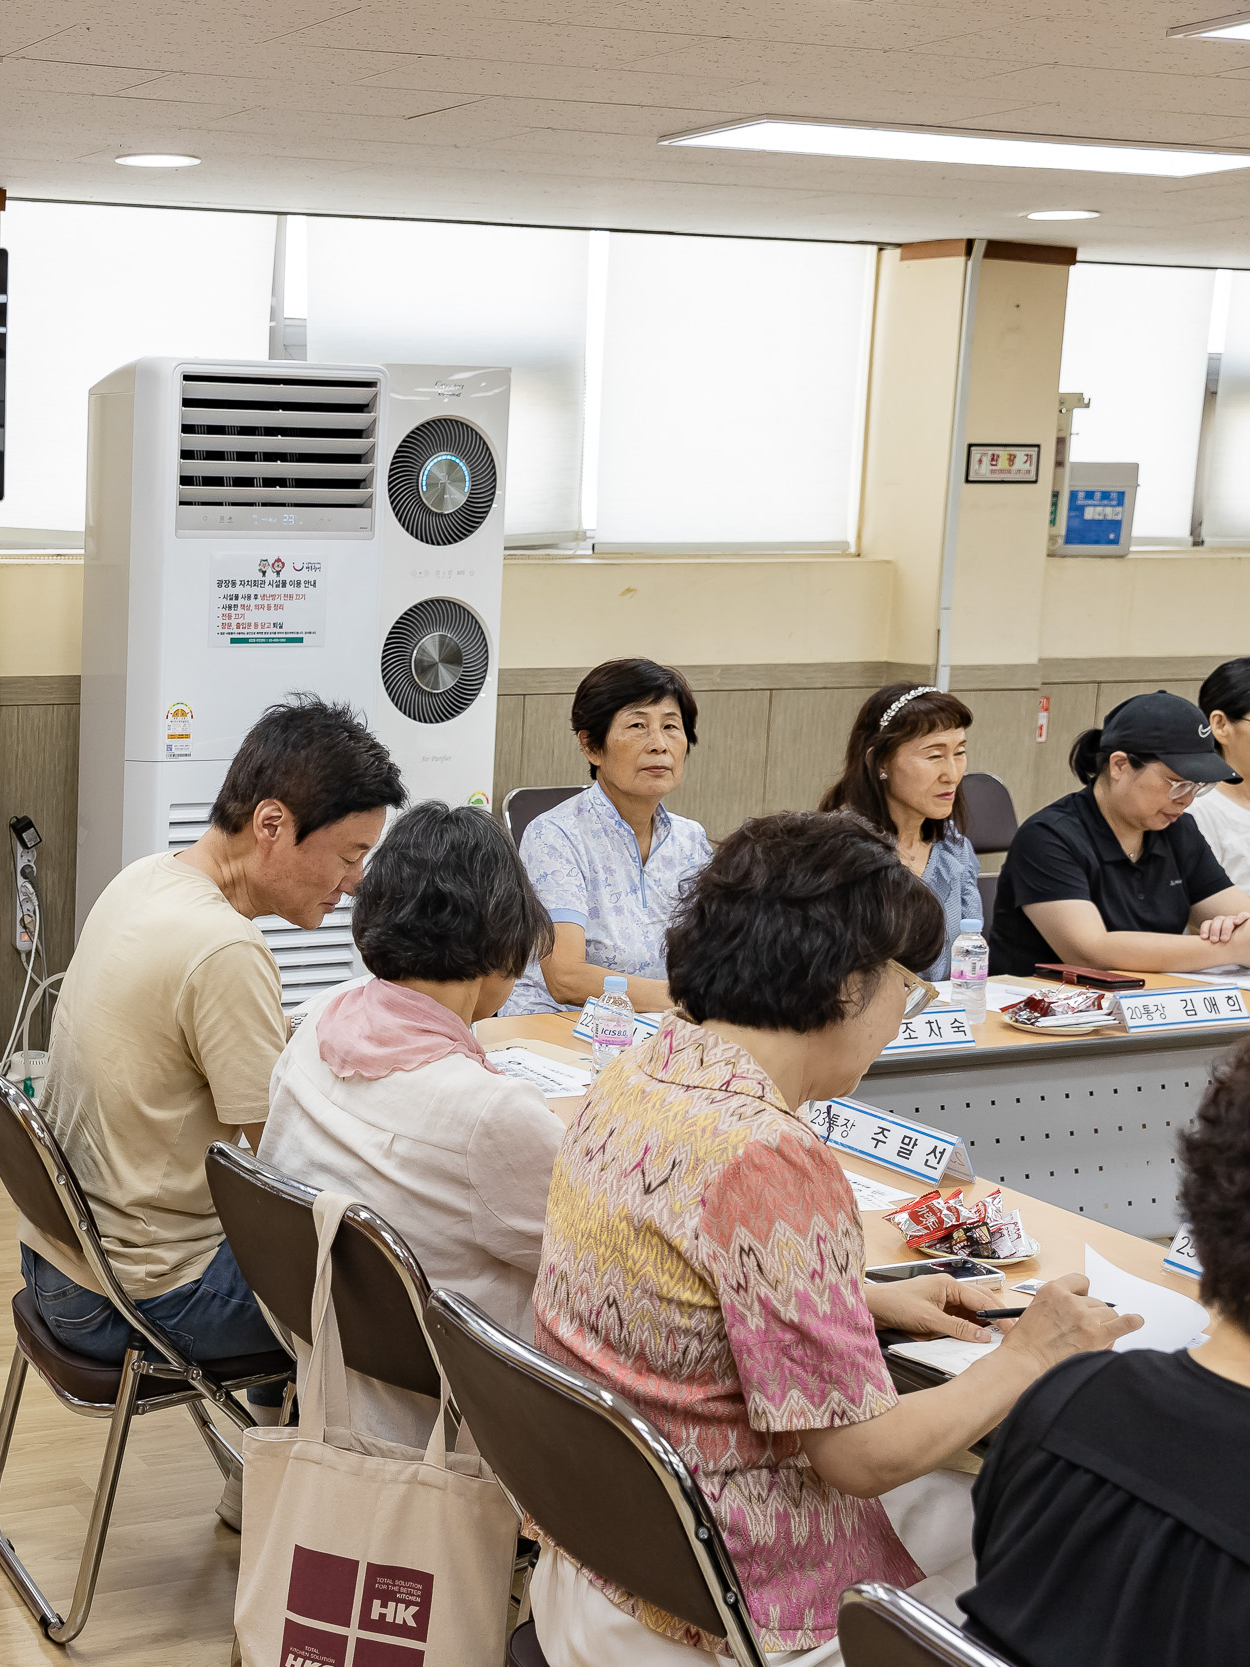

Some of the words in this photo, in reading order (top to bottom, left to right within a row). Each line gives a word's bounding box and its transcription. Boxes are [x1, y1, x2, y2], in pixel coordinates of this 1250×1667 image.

[216, 579, 237, 589] 광장동
[239, 579, 266, 589] 자치회관
[268, 580, 287, 588] 시설물
[289, 580, 302, 588] 이용
[303, 580, 317, 588] 안내
[222, 593, 239, 601] 시설물
[260, 593, 282, 601] 냉난방기
[1126, 1003, 1167, 1021] 20통장
[1179, 994, 1243, 1017] 김애희
[600, 1027, 617, 1037] ICIS
[810, 1107, 856, 1139] 23통장
[870, 1125, 947, 1171] 주말선
[376, 1577, 393, 1585] TOTAL
[394, 1580, 423, 1589] SOLUTION
[400, 1586, 422, 1596] BETTER
[396, 1593, 421, 1602] KITCHEN
[370, 1599, 420, 1628] HK
[304, 1645, 319, 1654] TOTAL
[310, 1653, 336, 1664] SOLUTION
